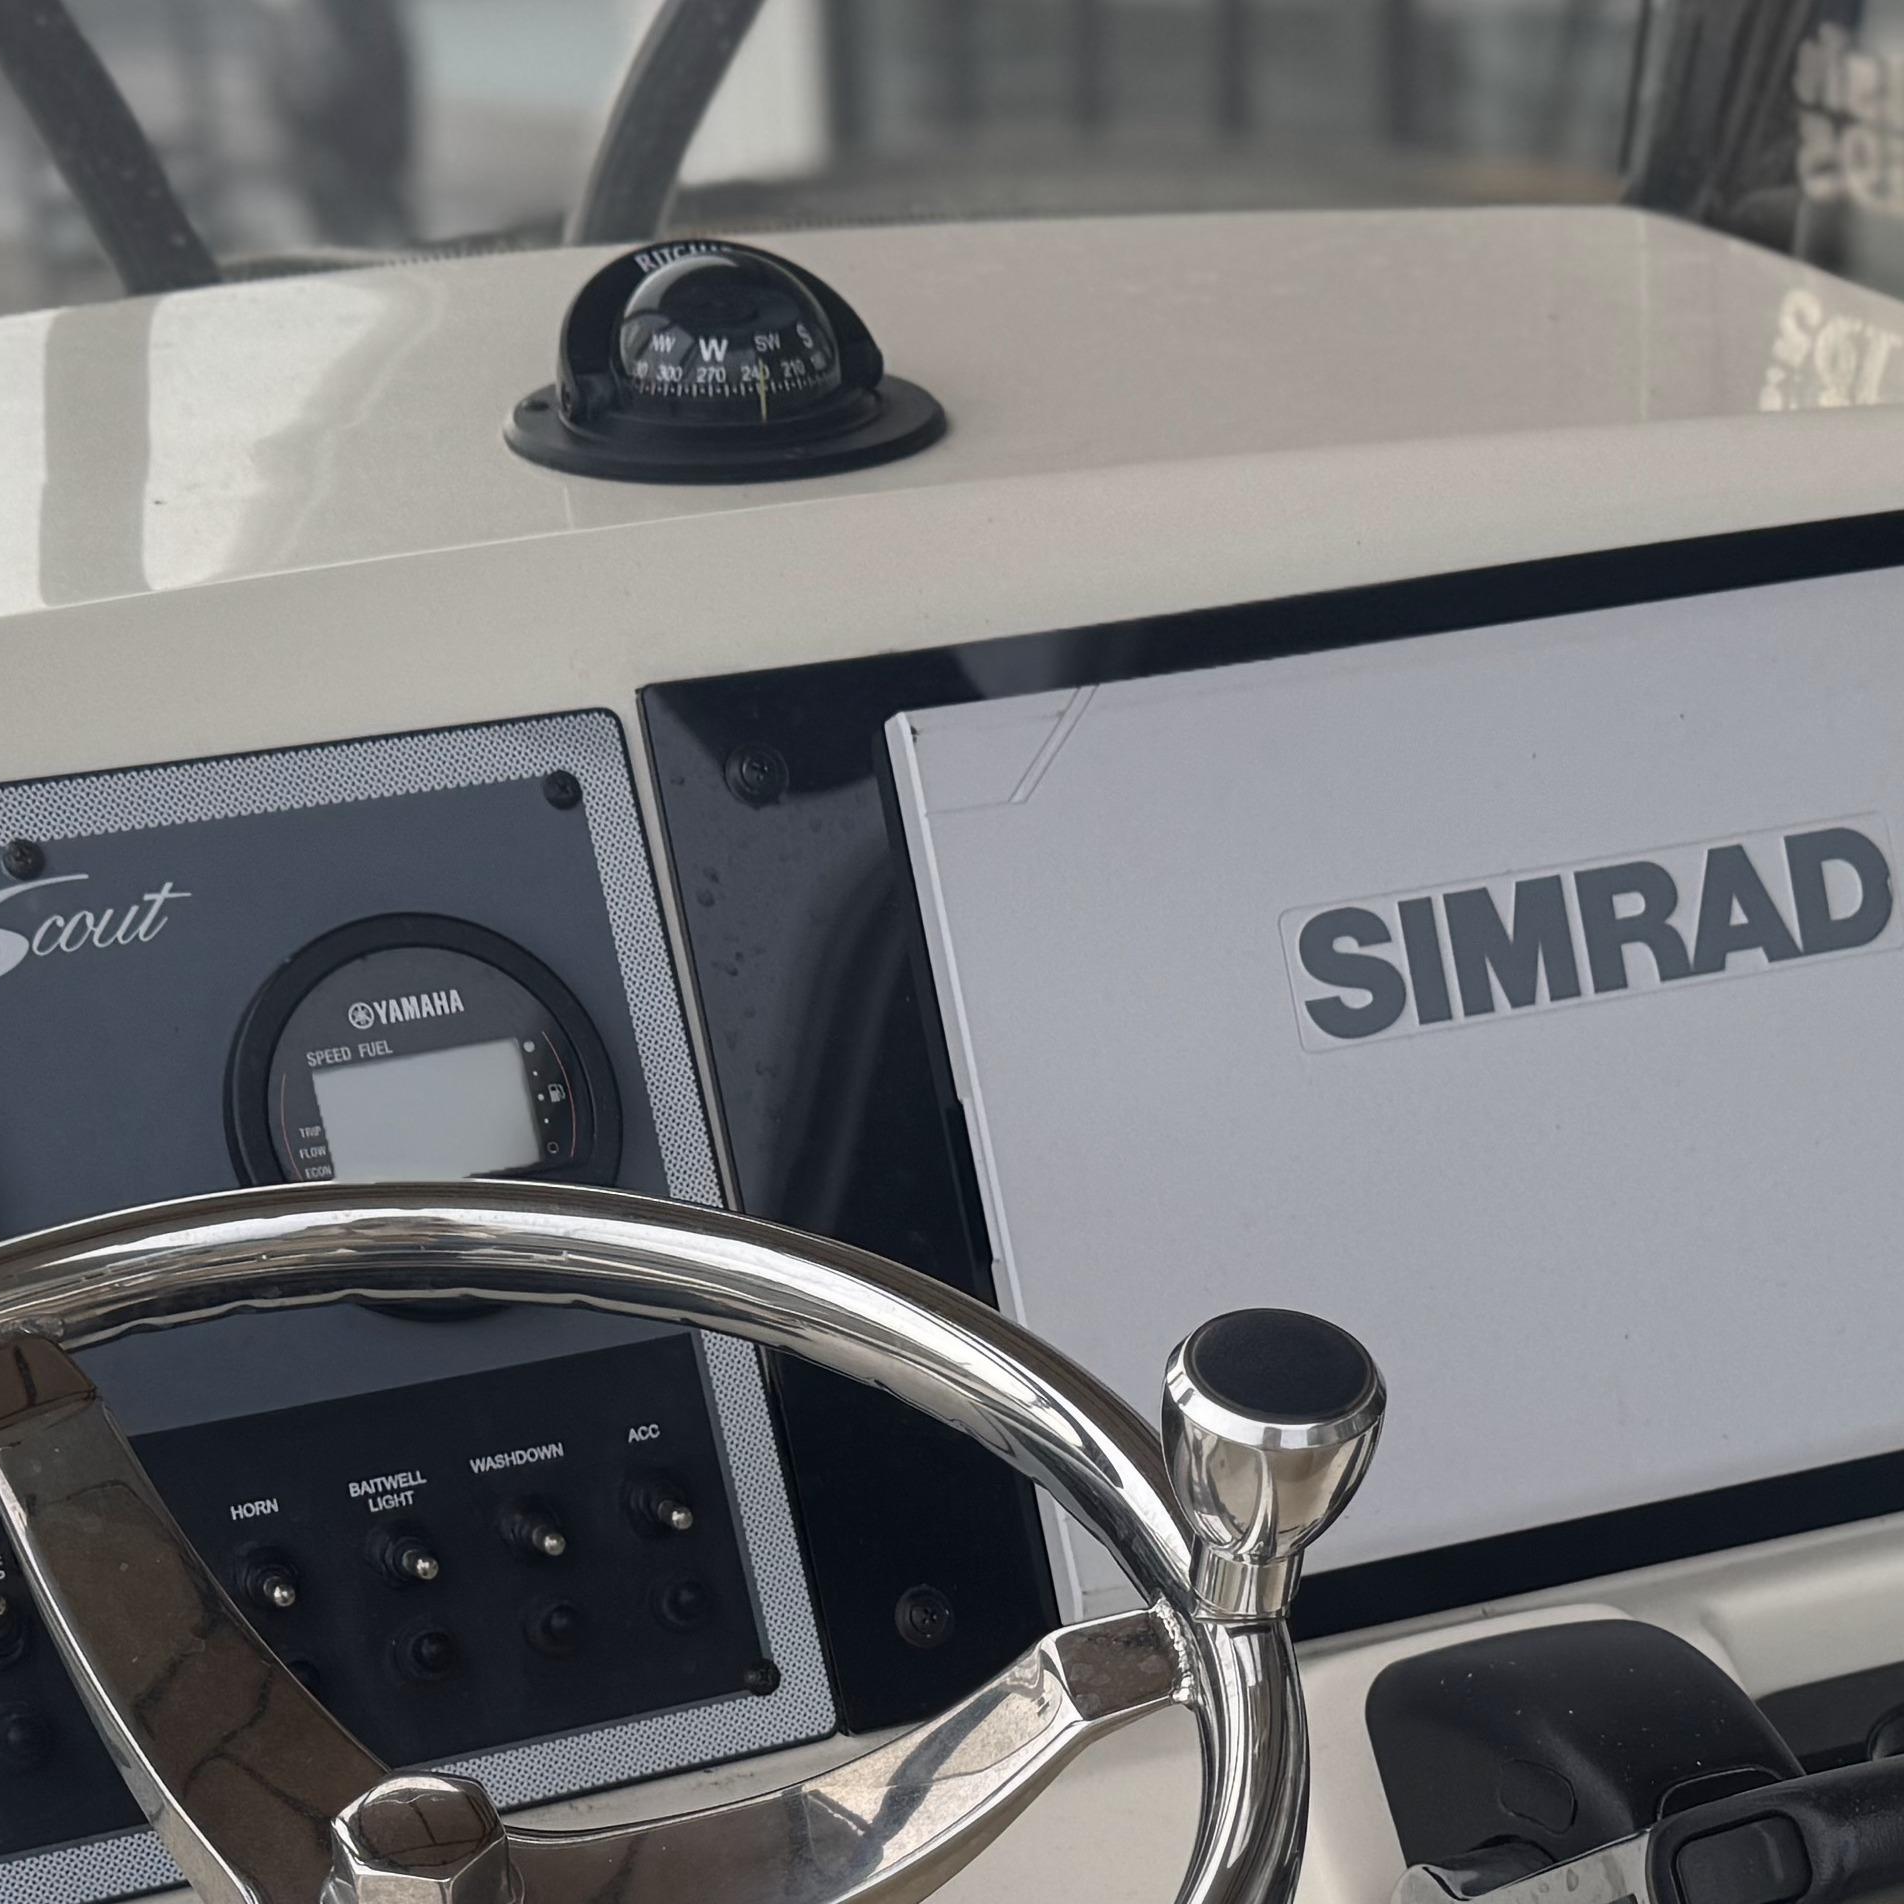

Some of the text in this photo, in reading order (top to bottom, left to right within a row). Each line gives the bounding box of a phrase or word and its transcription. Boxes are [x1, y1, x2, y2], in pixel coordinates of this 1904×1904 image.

[699, 337, 729, 362] W
[754, 333, 781, 352] SW
[697, 366, 727, 384] 270
[1298, 827, 1893, 1040] SIMRAD
[373, 989, 465, 1025] YAMAHA
[306, 1040, 394, 1068] SPEED FUEL
[299, 1126, 322, 1139] TRIP
[299, 1145, 326, 1160] FLOW
[305, 1164, 332, 1180] ECON
[627, 1423, 660, 1444] ACC
[469, 1442, 565, 1474] WASHDOWN
[348, 1470, 427, 1499] BAITWELL
[229, 1497, 280, 1522] HORN
[368, 1489, 416, 1514] LIGHT
